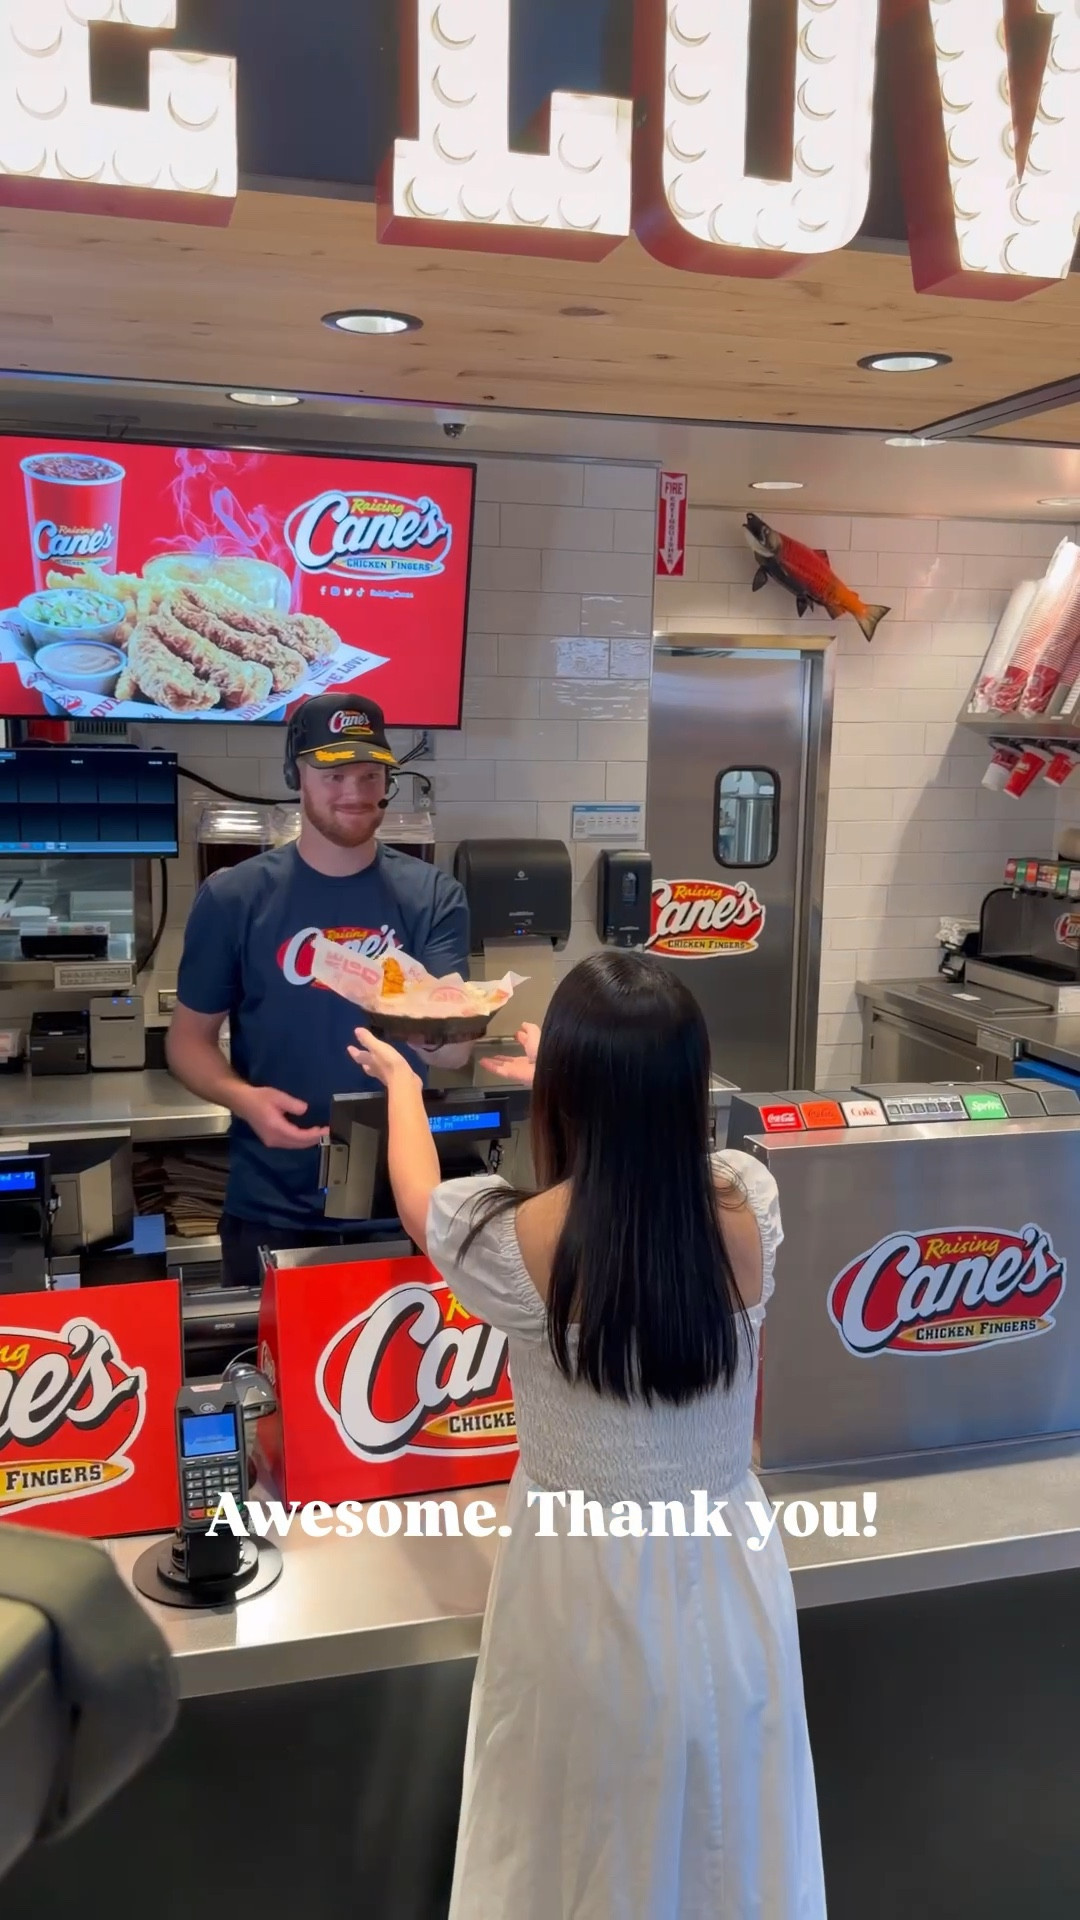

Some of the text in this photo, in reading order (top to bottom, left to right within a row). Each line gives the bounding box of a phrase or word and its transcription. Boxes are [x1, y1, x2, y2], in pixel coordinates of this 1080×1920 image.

[665, 481, 683, 495] FIRE
[350, 498, 405, 516] Raising
[294, 490, 450, 570] Cane's
[34, 520, 115, 561] Cane's
[346, 558, 431, 571] CHICKEN FINGERS
[329, 710, 371, 734] Cane's
[673, 884, 723, 901] Raising
[667, 939, 746, 949] CHICKEN FINGERS
[850, 1106, 878, 1117] Coke
[971, 1100, 1002, 1112] Sprite
[923, 1235, 1002, 1261] Raising
[841, 1226, 1064, 1353] Cane's
[915, 1318, 1037, 1341] CHICKEN FINGERS
[5, 1464, 102, 1491] FINGERS
